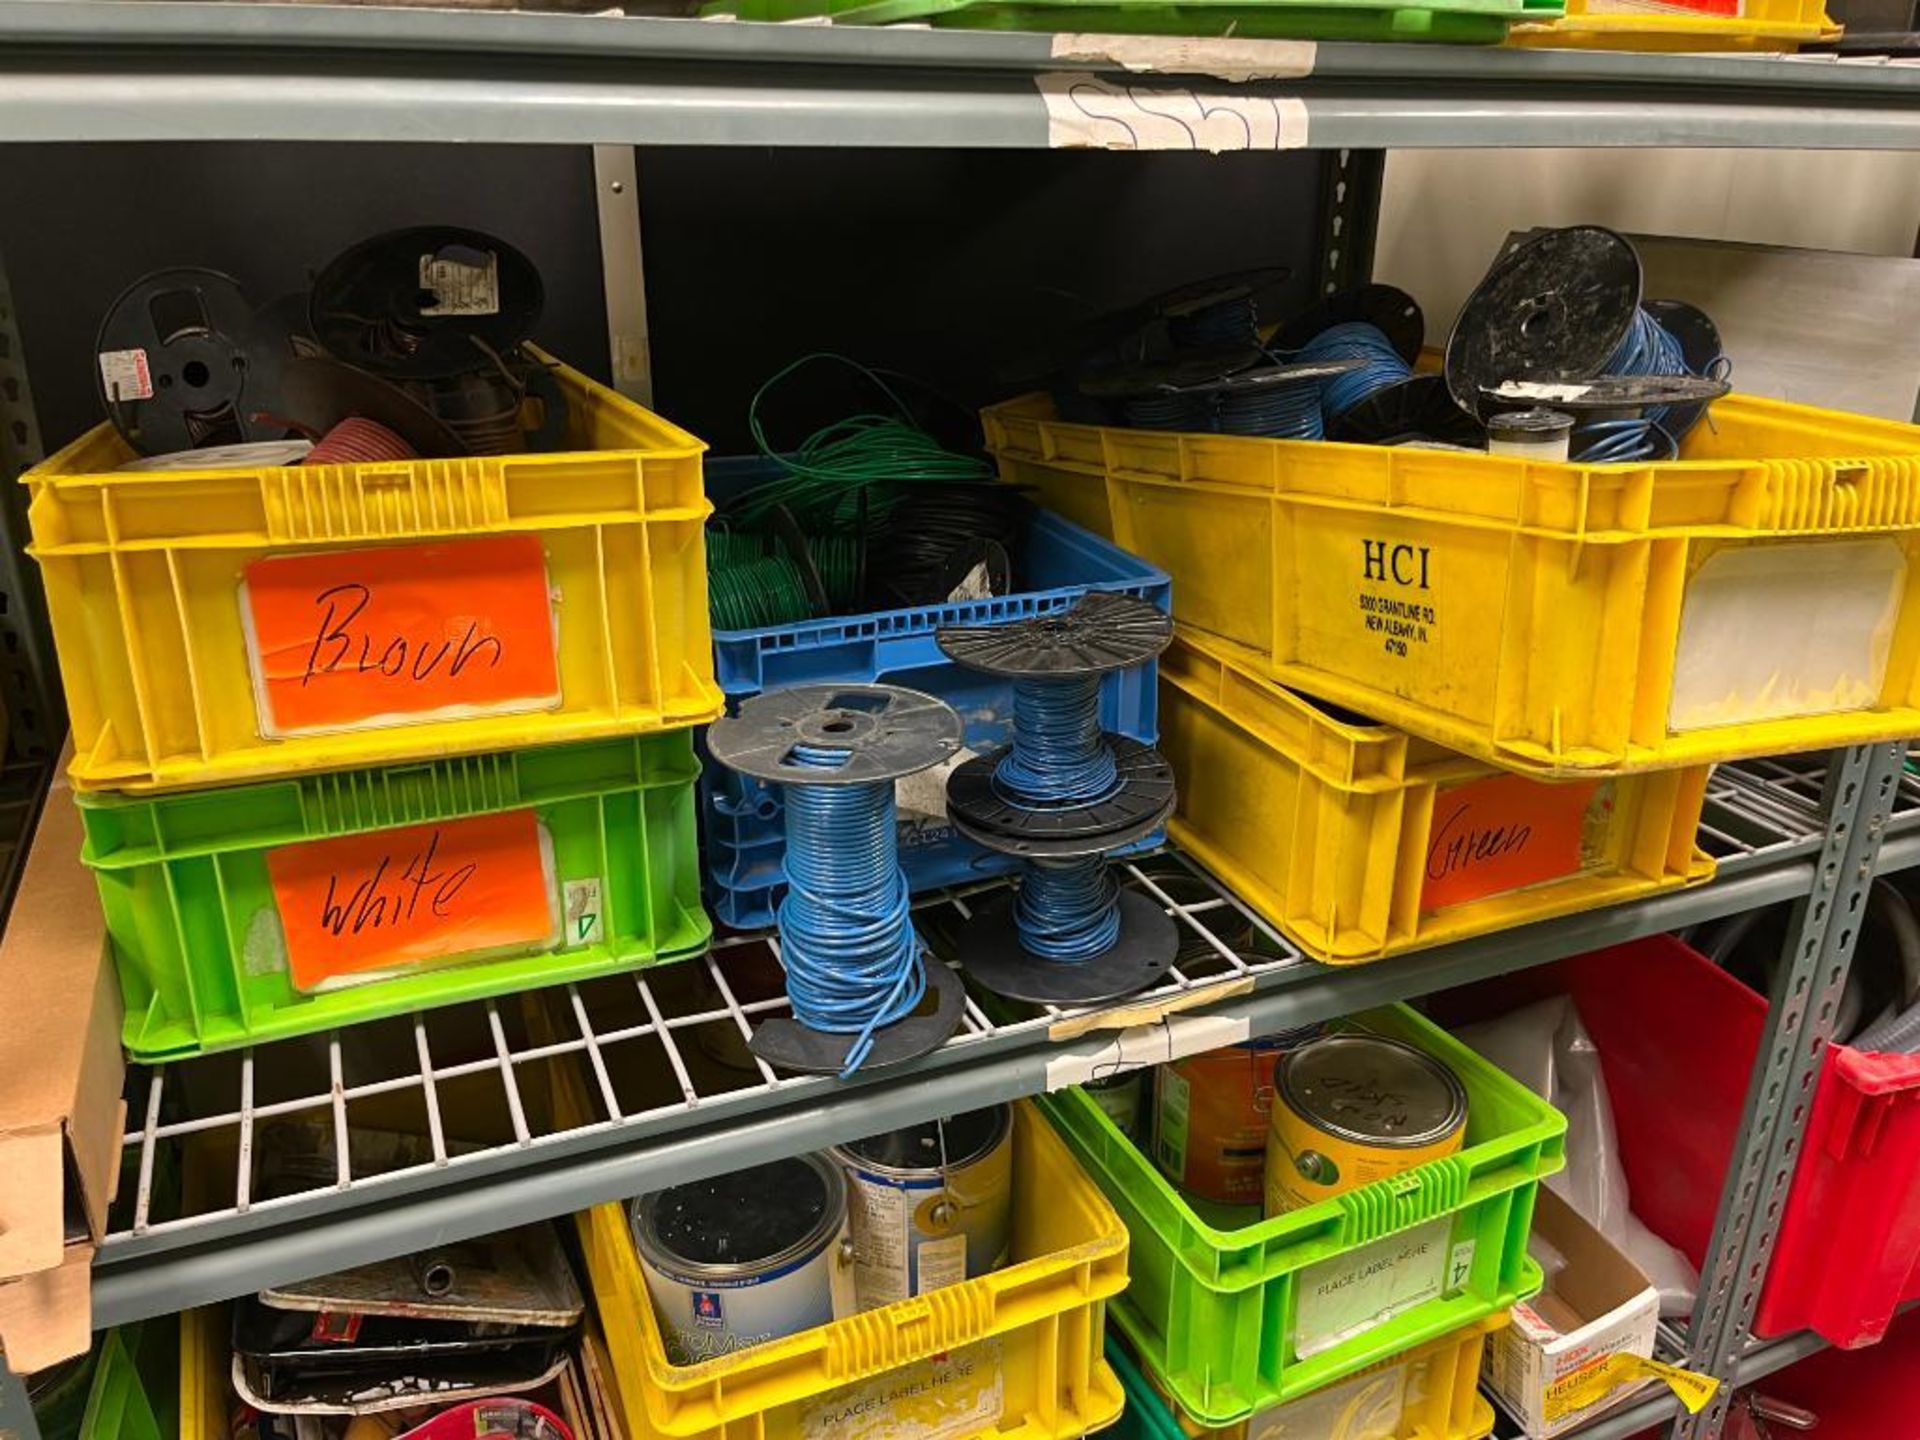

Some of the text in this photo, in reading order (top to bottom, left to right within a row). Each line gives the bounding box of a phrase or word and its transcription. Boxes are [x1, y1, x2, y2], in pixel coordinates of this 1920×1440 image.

[1362, 538, 1430, 589] HCI
[1426, 803, 1531, 881] Green
[321, 830, 477, 936] White
[1318, 1275, 1355, 1296] PLACE
[1357, 1258, 1394, 1281] LABEL
[823, 1398, 875, 1427] PLACE
[879, 1380, 929, 1406] LABEL
[1546, 1361, 1609, 1401] HEUSER
